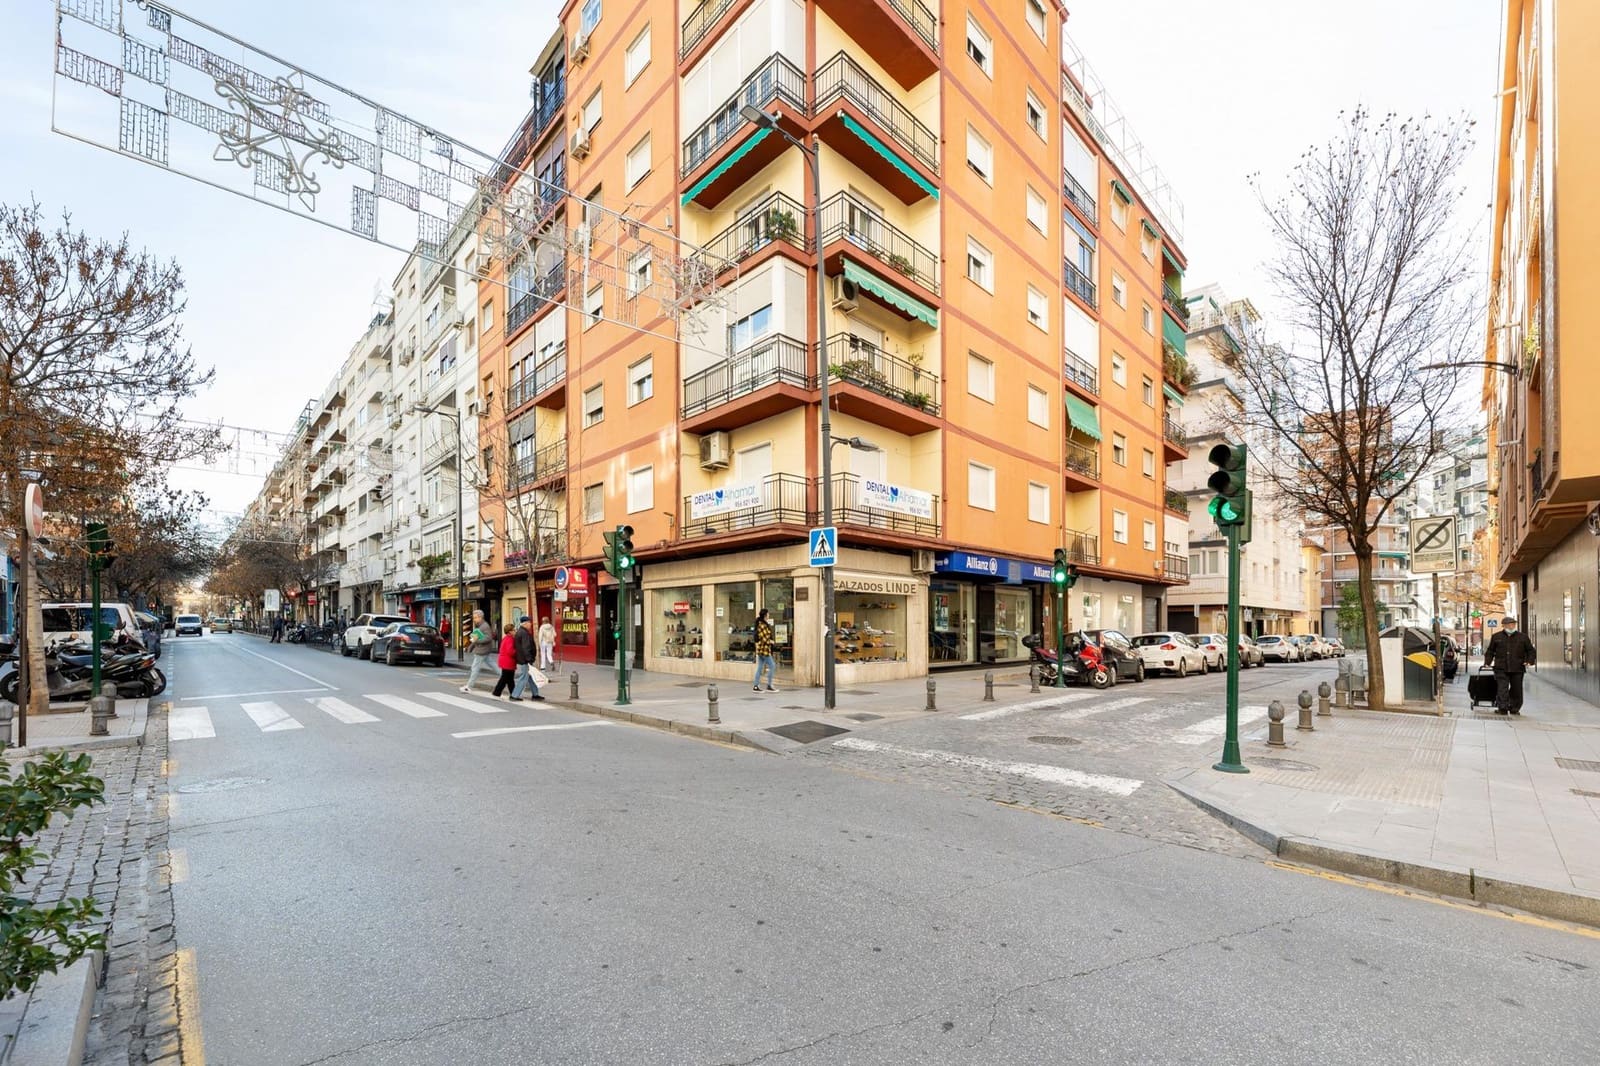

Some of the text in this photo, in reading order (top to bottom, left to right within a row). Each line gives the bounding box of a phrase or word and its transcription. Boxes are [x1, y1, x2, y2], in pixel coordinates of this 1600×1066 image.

[866, 480, 890, 495] DENTAL
[694, 492, 715, 505] DENTAL
[724, 486, 756, 499] Alhamar
[966, 556, 989, 571] Allianz
[1033, 567, 1051, 578] Allianz
[834, 580, 917, 594] CALZADOS LINDE
